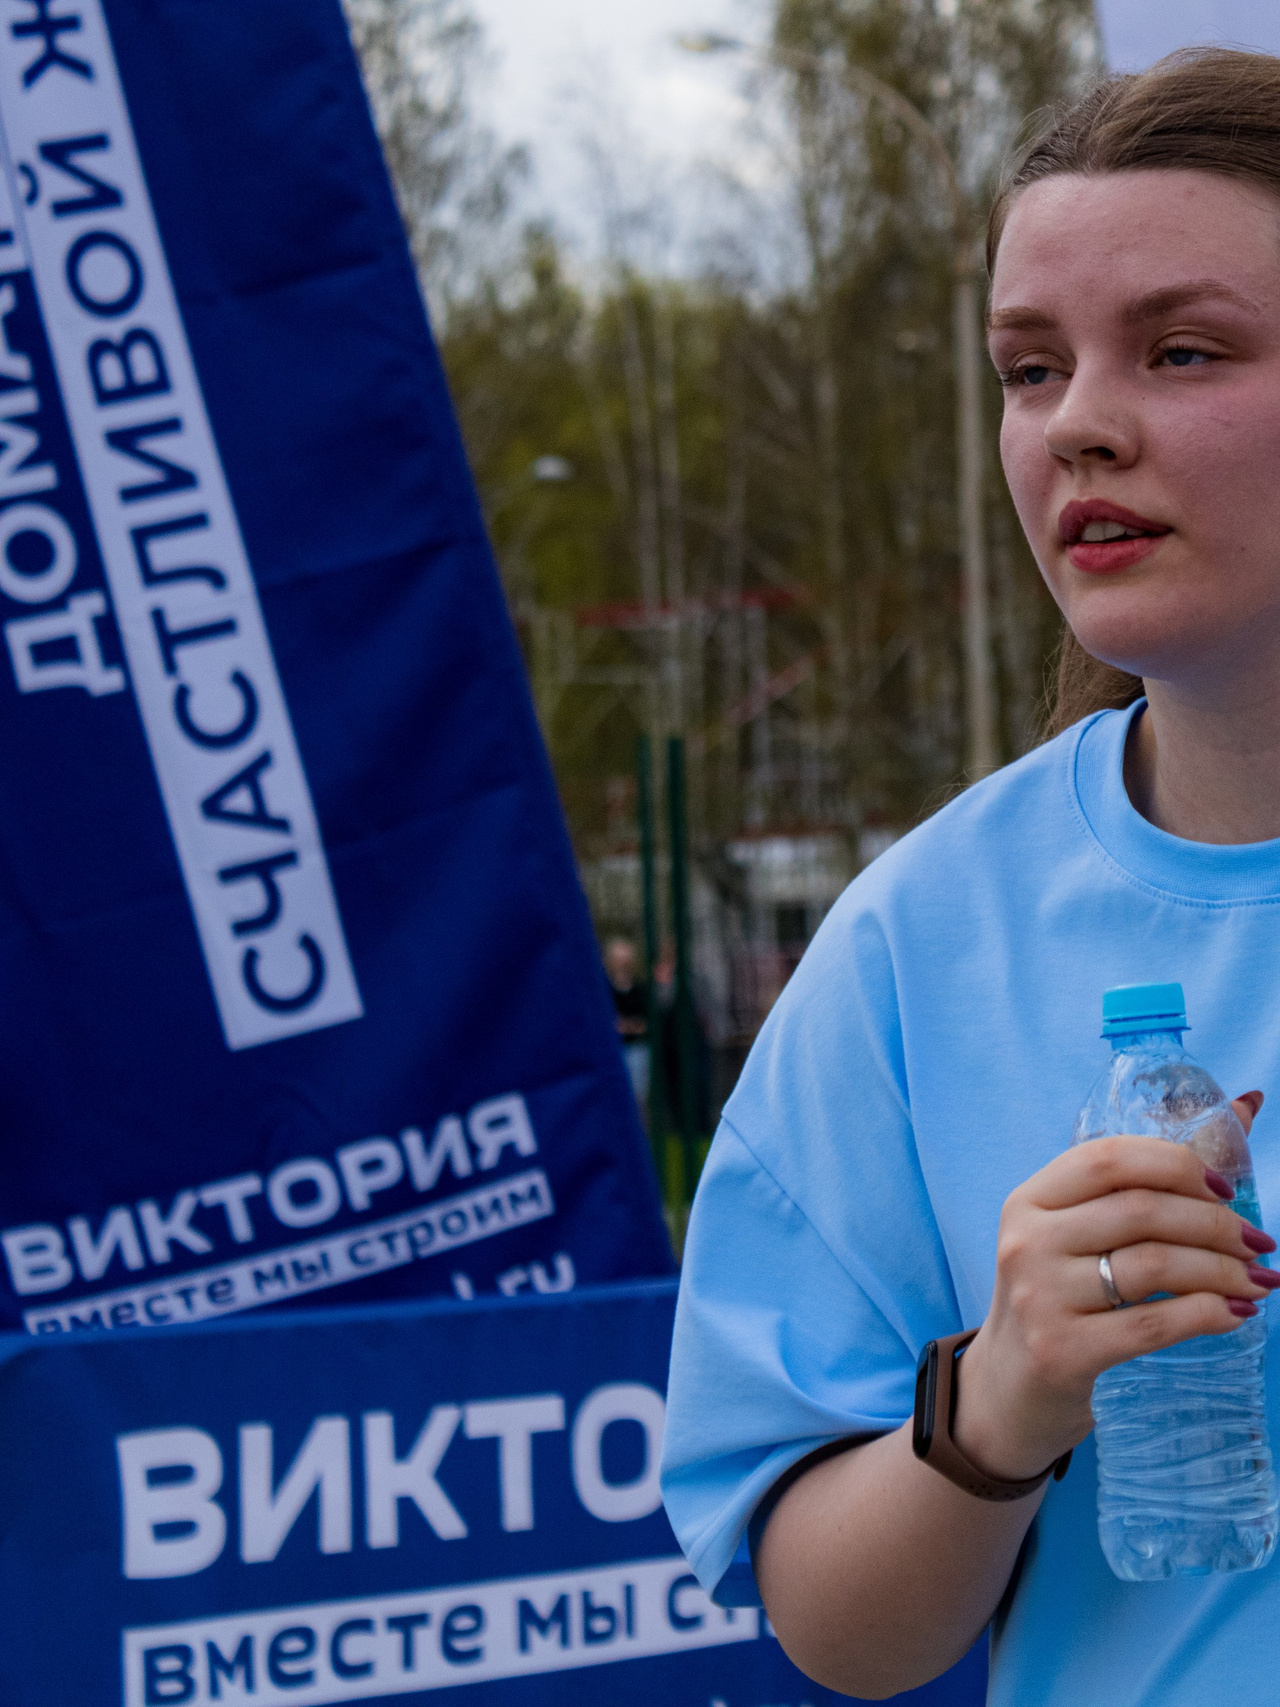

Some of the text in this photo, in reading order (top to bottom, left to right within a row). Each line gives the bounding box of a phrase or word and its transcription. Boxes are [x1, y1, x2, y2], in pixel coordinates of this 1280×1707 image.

[18, 133, 326, 1017] СЧАСТЛИВОЙ
[0, 1091, 538, 1297] ВИКТОРИЯ
[116, 1382, 667, 1579] ВИКТО
[518, 1583, 636, 1656] мы
